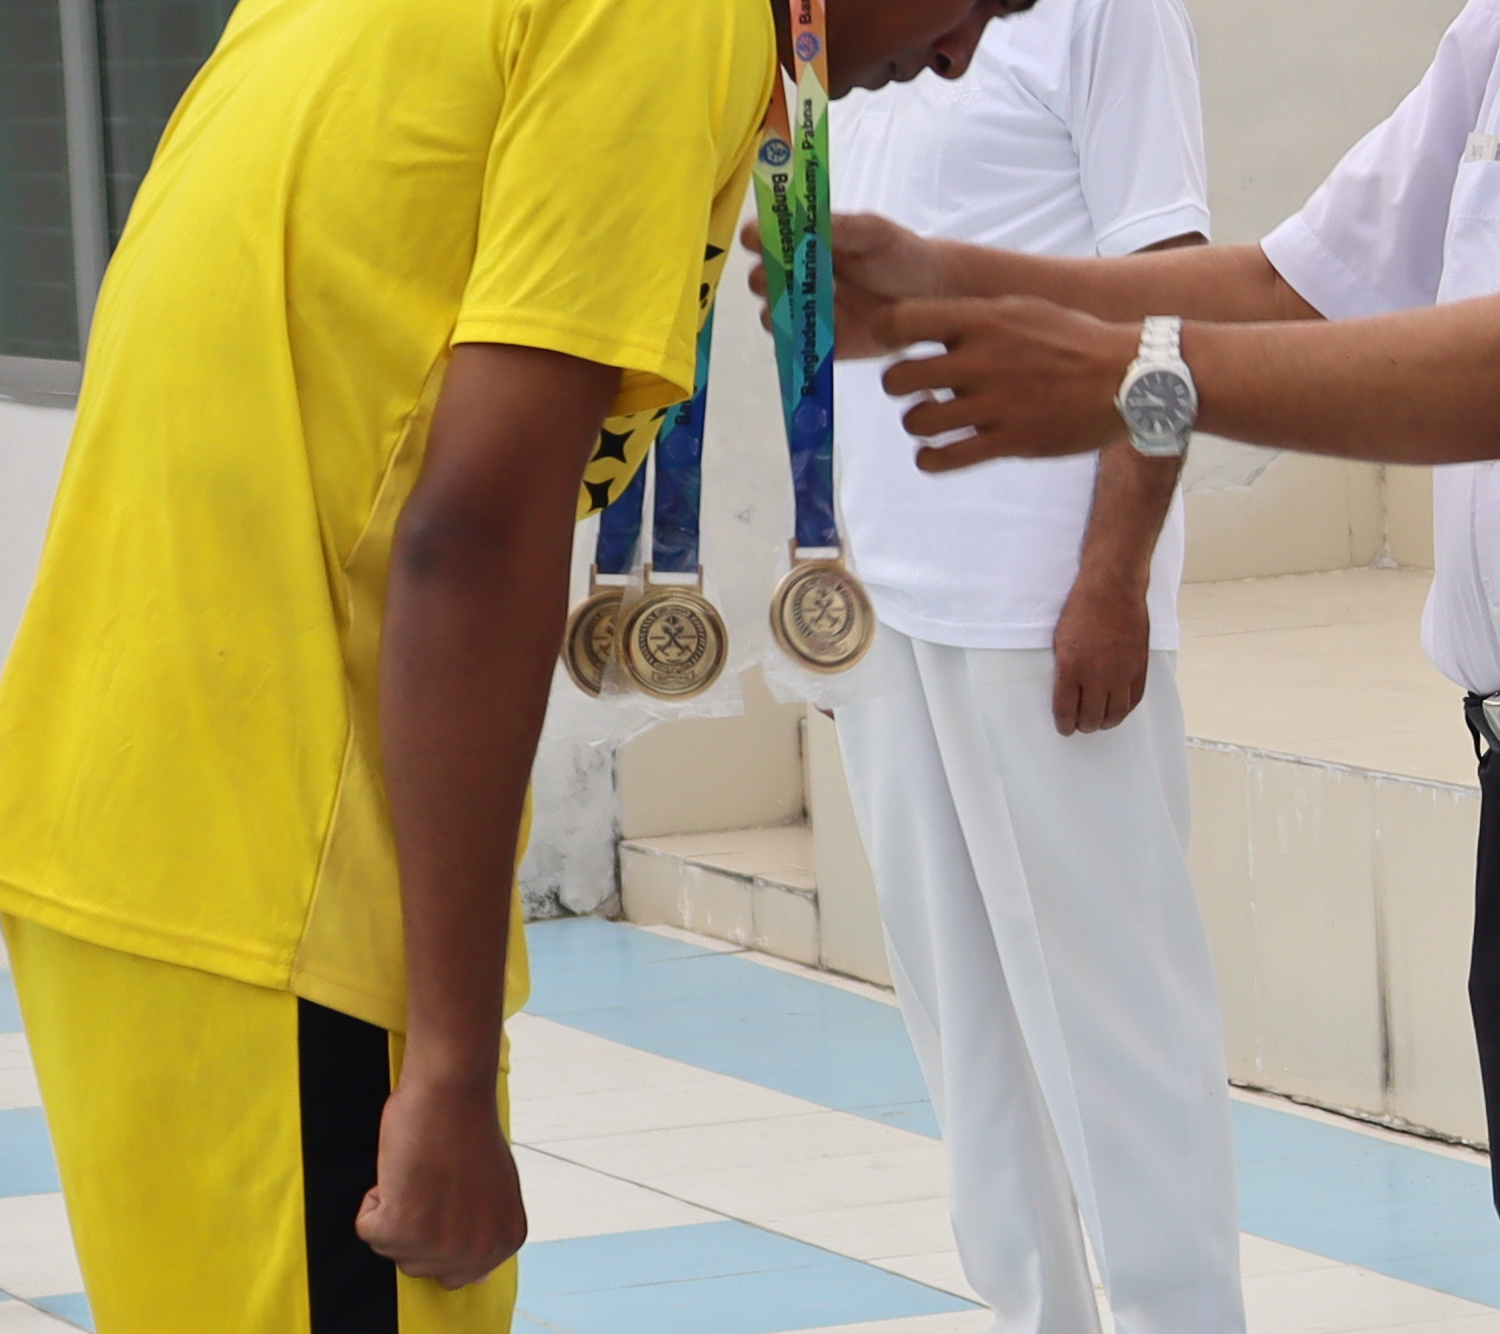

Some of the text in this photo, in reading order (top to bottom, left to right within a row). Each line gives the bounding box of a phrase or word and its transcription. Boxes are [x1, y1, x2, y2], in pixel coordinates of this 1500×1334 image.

[801, 98, 814, 151] Pabna
[802, 238, 817, 295] Marine
[802, 299, 819, 396] Bangladesh
